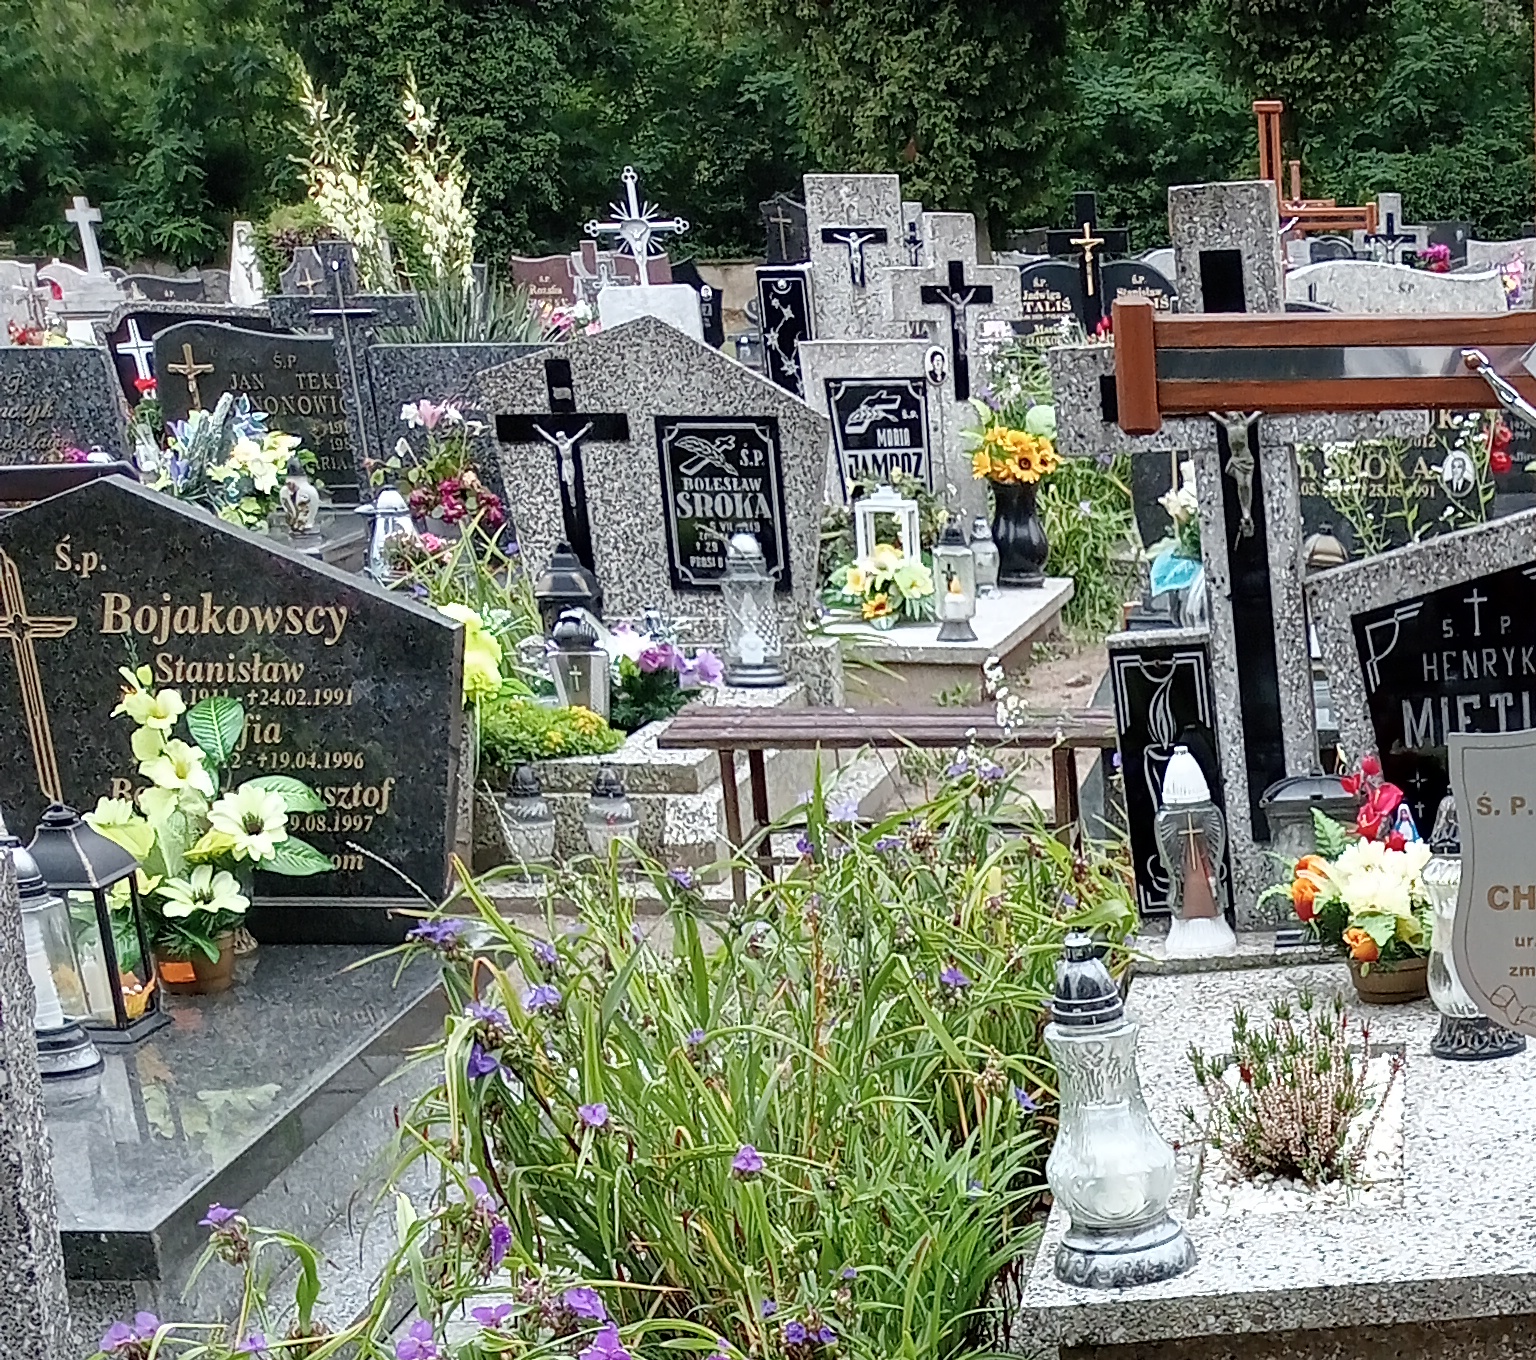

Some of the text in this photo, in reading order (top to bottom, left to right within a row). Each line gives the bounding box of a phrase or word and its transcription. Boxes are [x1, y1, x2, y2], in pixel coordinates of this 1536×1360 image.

[230, 372, 265, 390] JAN
[876, 428, 911, 447] MARIA
[681, 477, 762, 492] BOLESŁAW
[676, 492, 772, 519] SROKA
[55, 535, 108, 579] Ś.p.
[101, 592, 349, 646] Bojakowscy
[155, 652, 305, 685] Stanisław
[1422, 645, 1536, 682] HENRYK
[1476, 791, 1534, 816] Ś. P.
